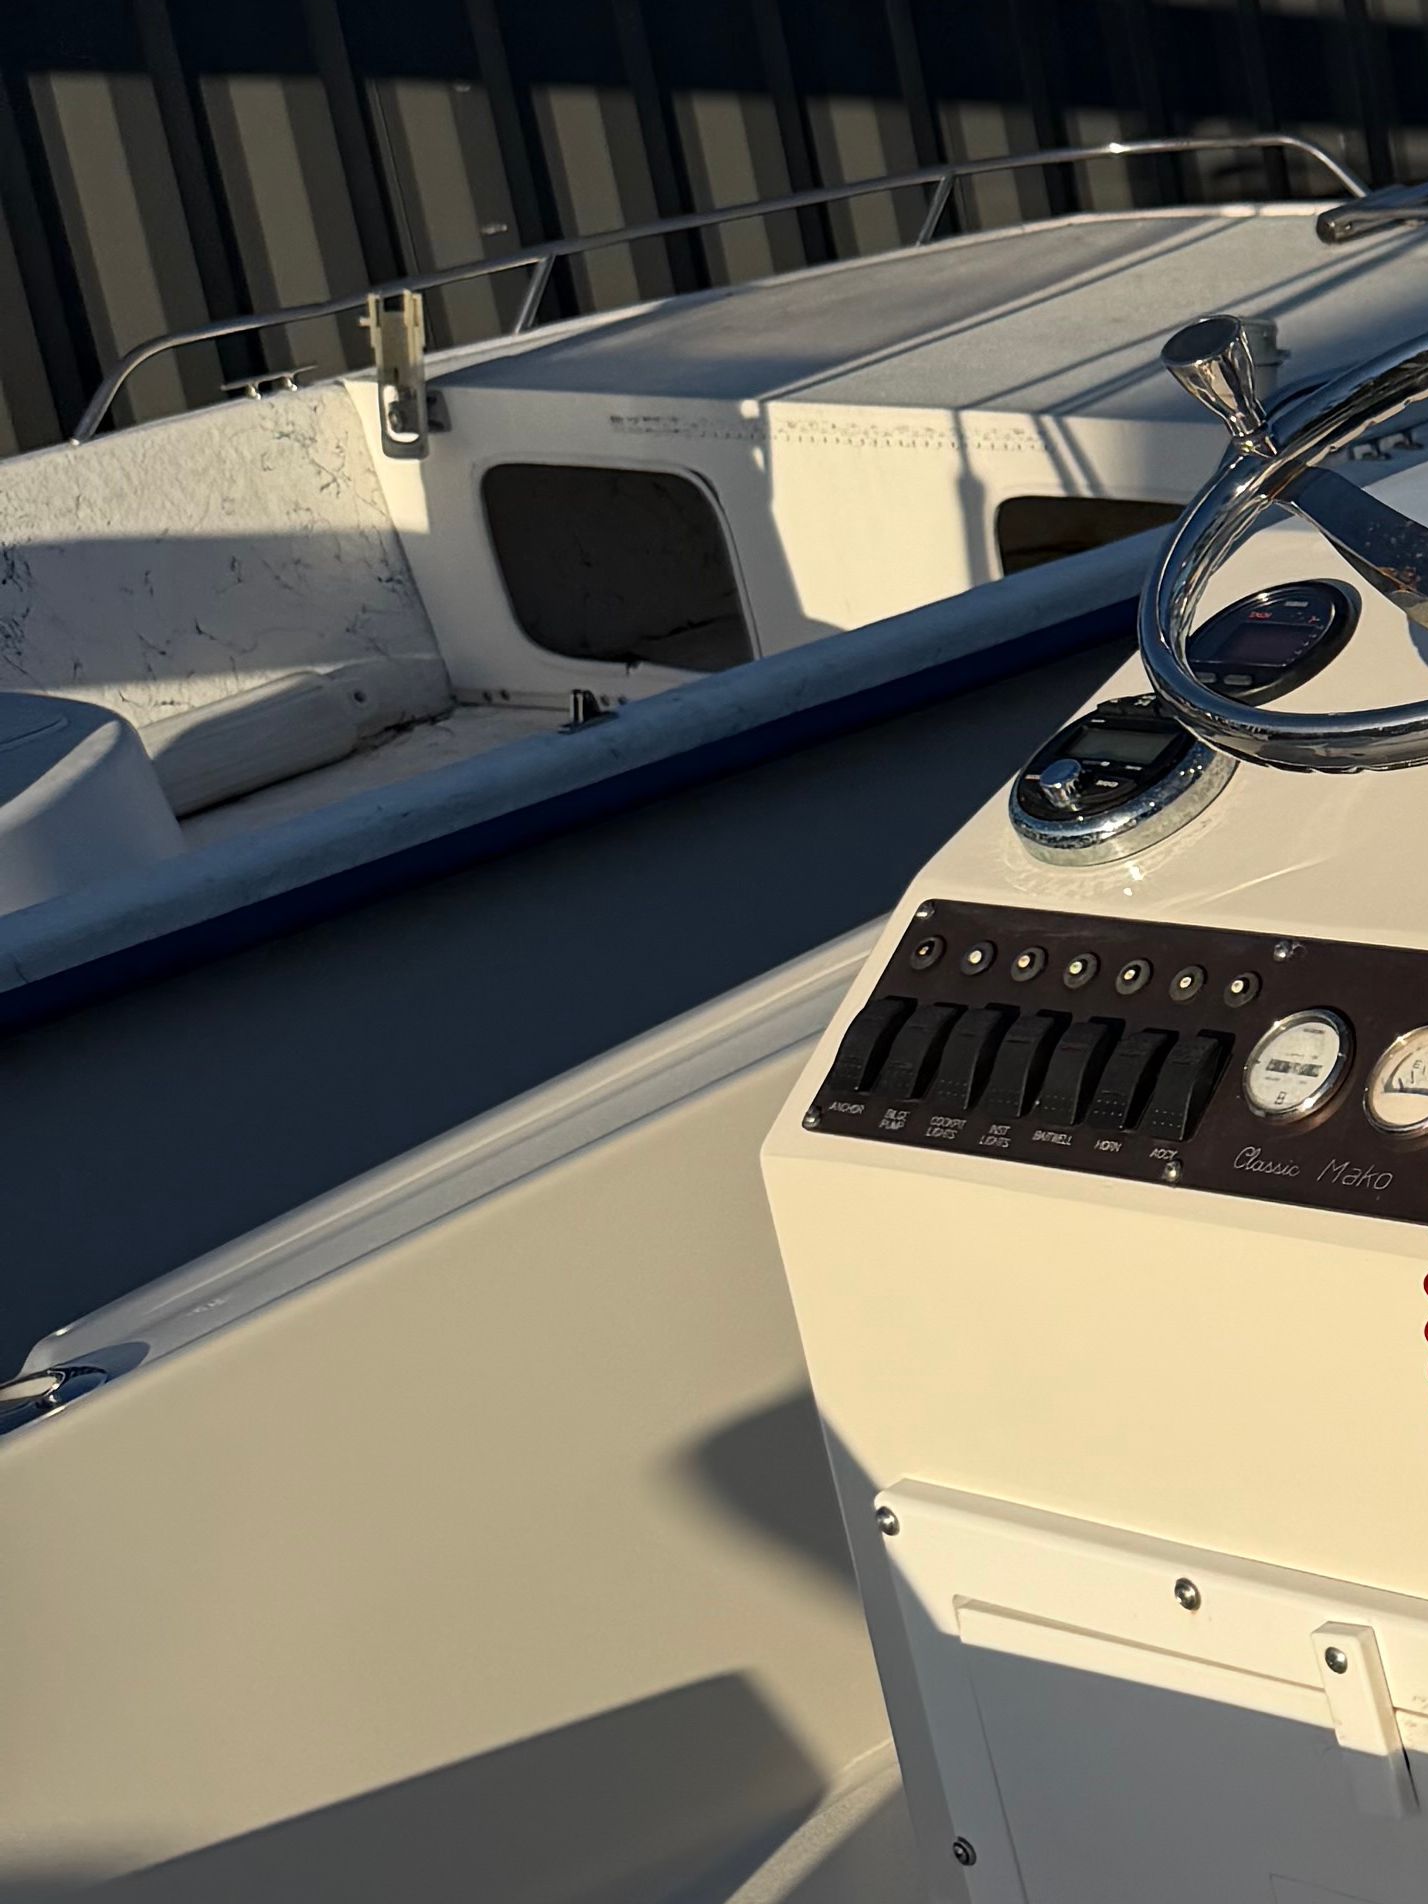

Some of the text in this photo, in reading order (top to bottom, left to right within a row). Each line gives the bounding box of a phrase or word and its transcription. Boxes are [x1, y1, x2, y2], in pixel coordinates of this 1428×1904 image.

[828, 1100, 866, 1115] ANCHOR
[878, 1119, 906, 1131] PUMP
[929, 1116, 968, 1129] COCKPIT
[925, 1127, 958, 1140] LIGHTS
[988, 1124, 1011, 1136] INST
[978, 1135, 1012, 1148] LIGHTS
[1032, 1129, 1073, 1146] BAITWELL
[1094, 1139, 1122, 1153] HORN
[1233, 1145, 1394, 1190] Classic Mako
